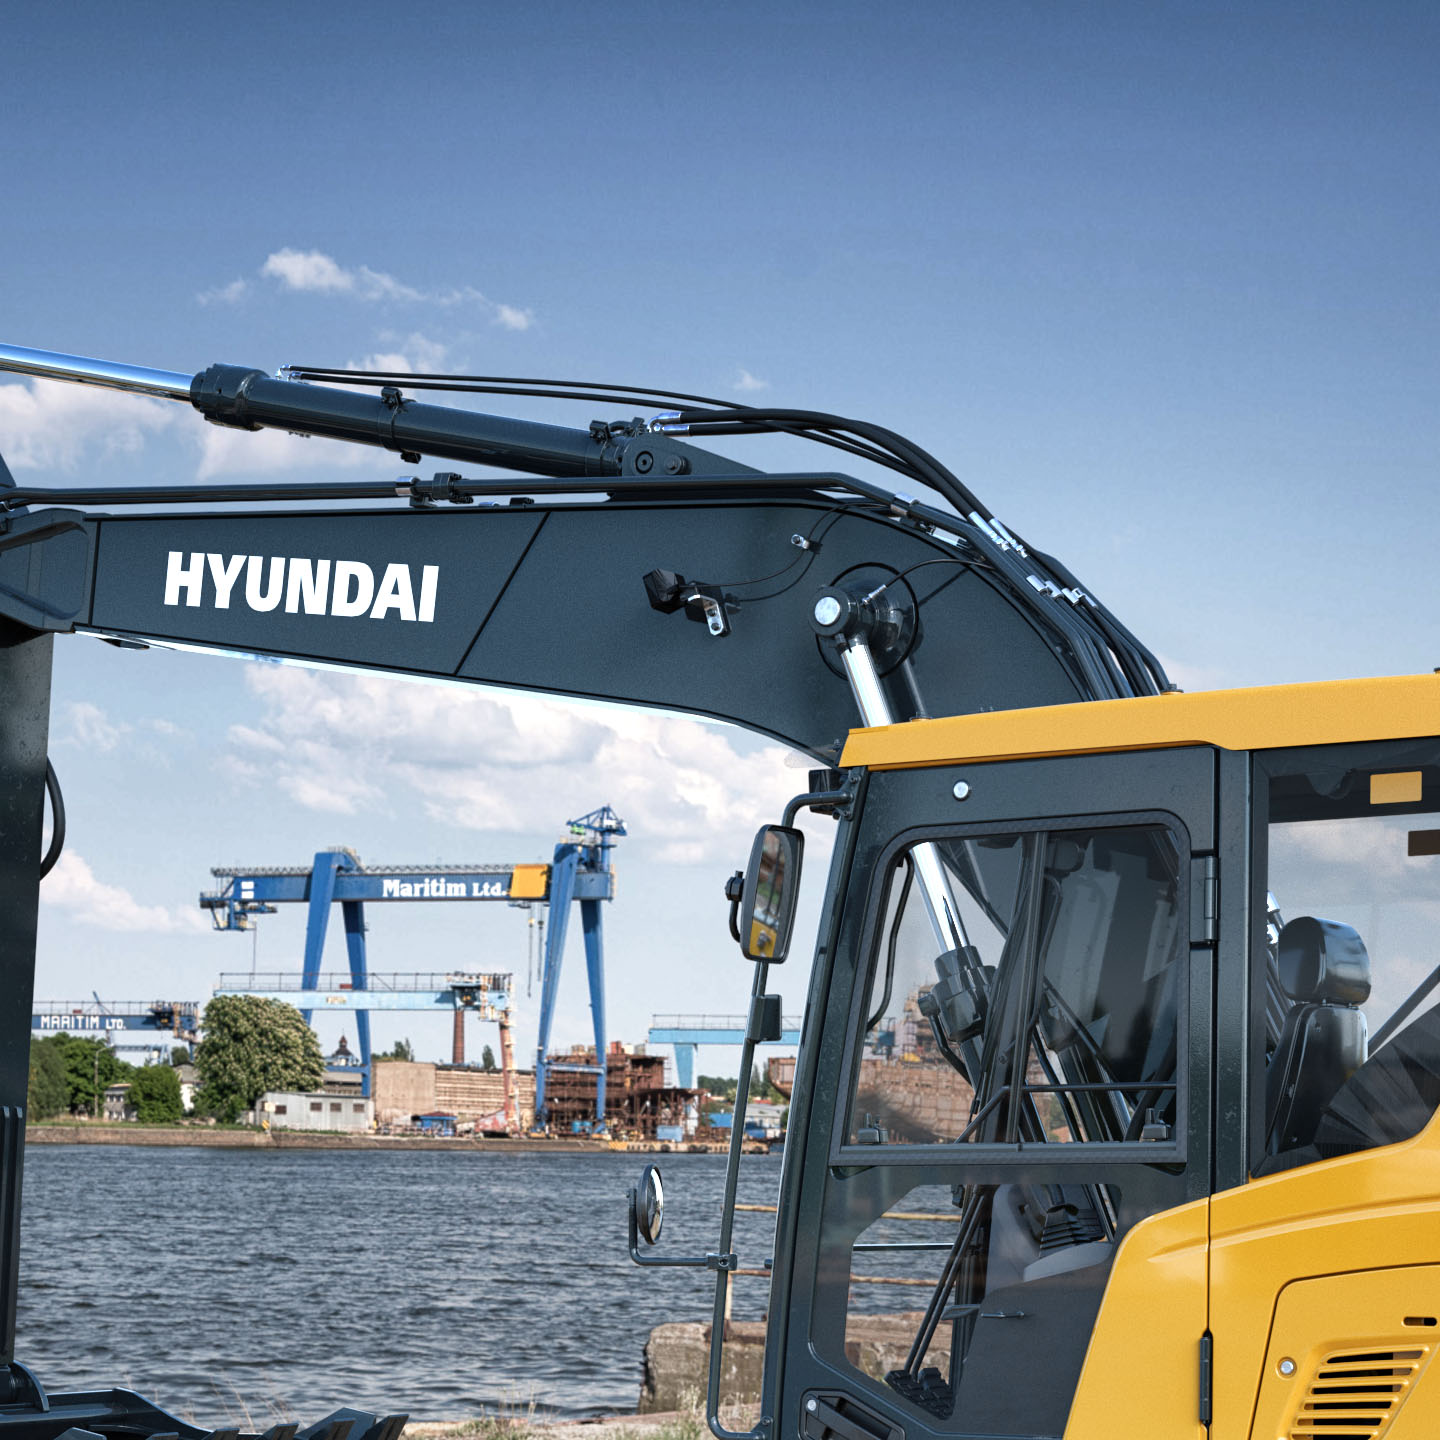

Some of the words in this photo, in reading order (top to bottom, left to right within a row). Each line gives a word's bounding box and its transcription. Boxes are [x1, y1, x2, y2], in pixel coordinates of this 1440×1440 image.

[164, 551, 439, 623] HYUNDAI
[382, 878, 467, 897] Maritim
[472, 882, 507, 896] Ltd.
[41, 1015, 100, 1029] MARITIM
[105, 1018, 127, 1030] LTD.
